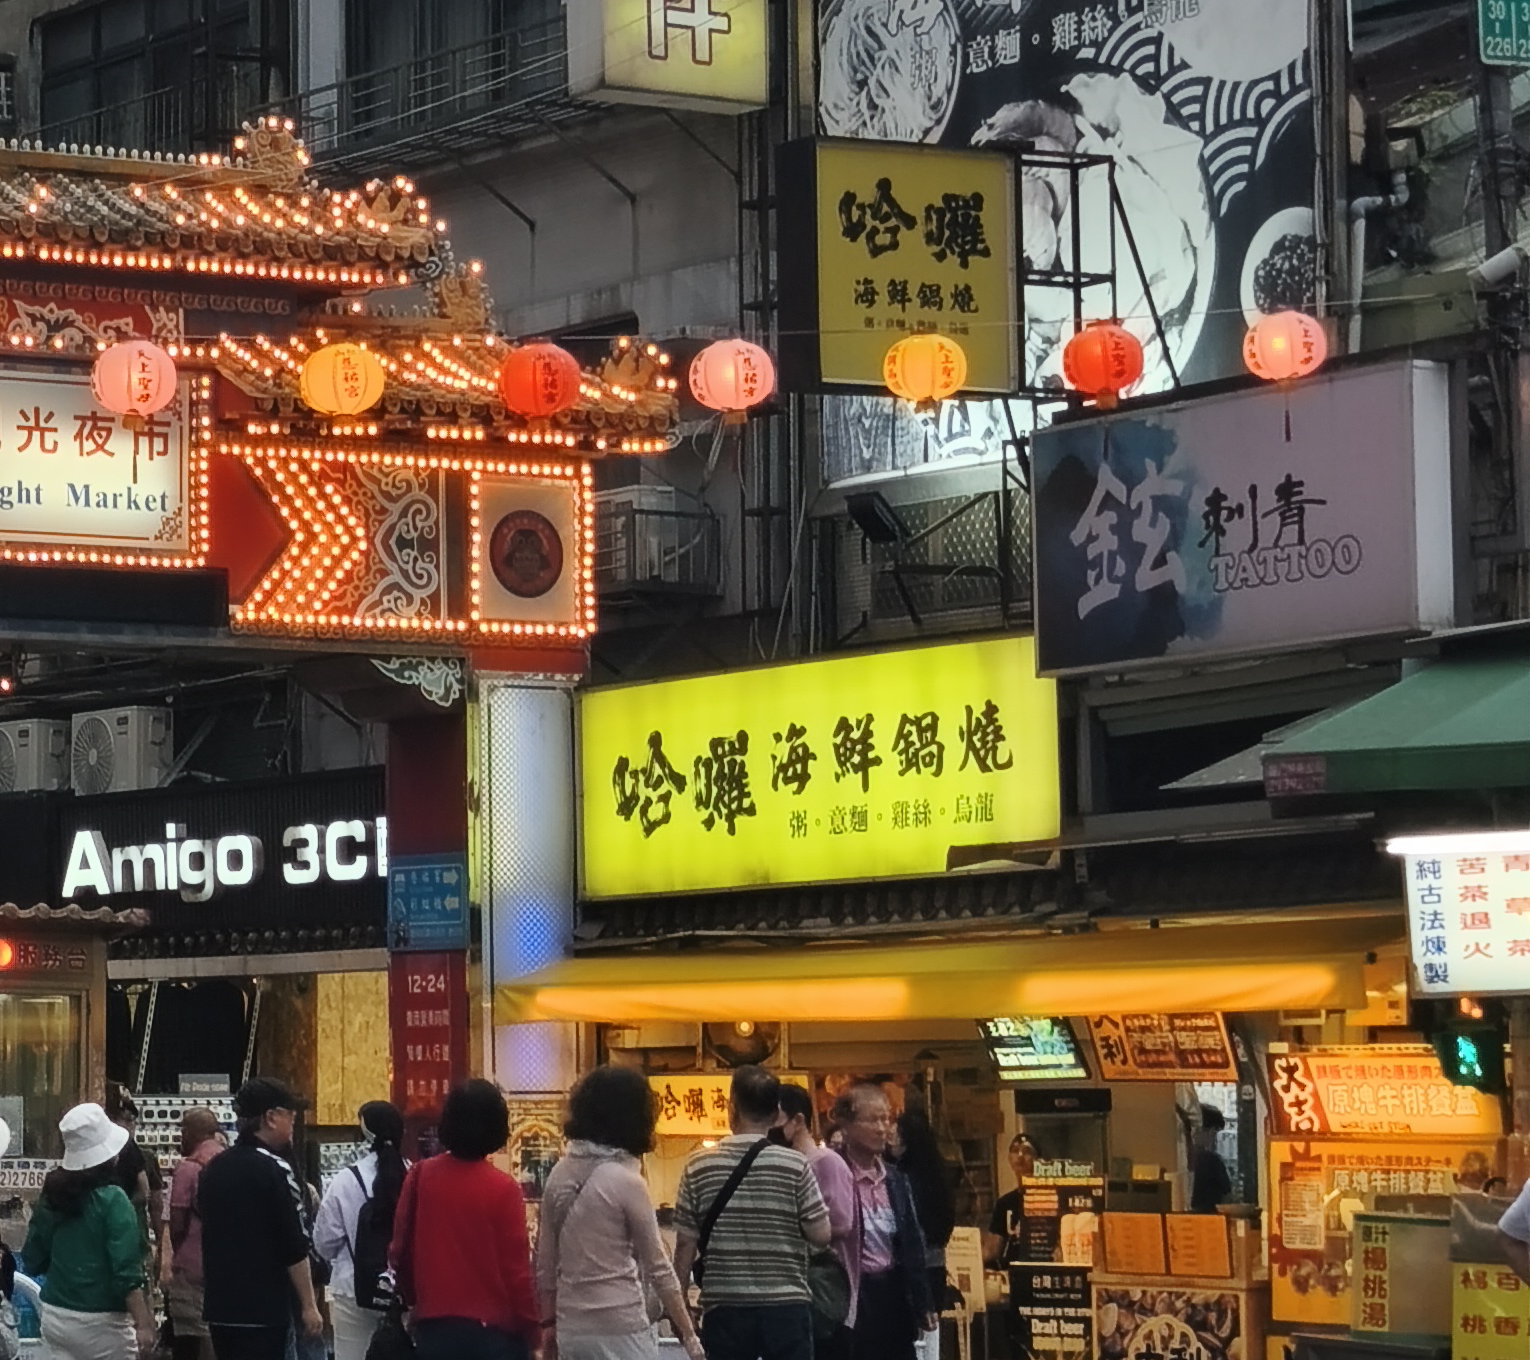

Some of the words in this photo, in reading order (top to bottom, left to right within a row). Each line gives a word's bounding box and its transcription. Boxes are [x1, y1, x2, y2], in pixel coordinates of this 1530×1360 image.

[1487, 0, 1506, 20] 30
[1485, 36, 1512, 56] 226
[854, 276, 979, 314] 海鮮鍋燒
[65, 483, 170, 514] Market
[1201, 472, 1328, 556] 刺青
[1208, 534, 1363, 594] TATTOO
[61, 822, 262, 903] Amigo
[282, 816, 388, 886] 3C
